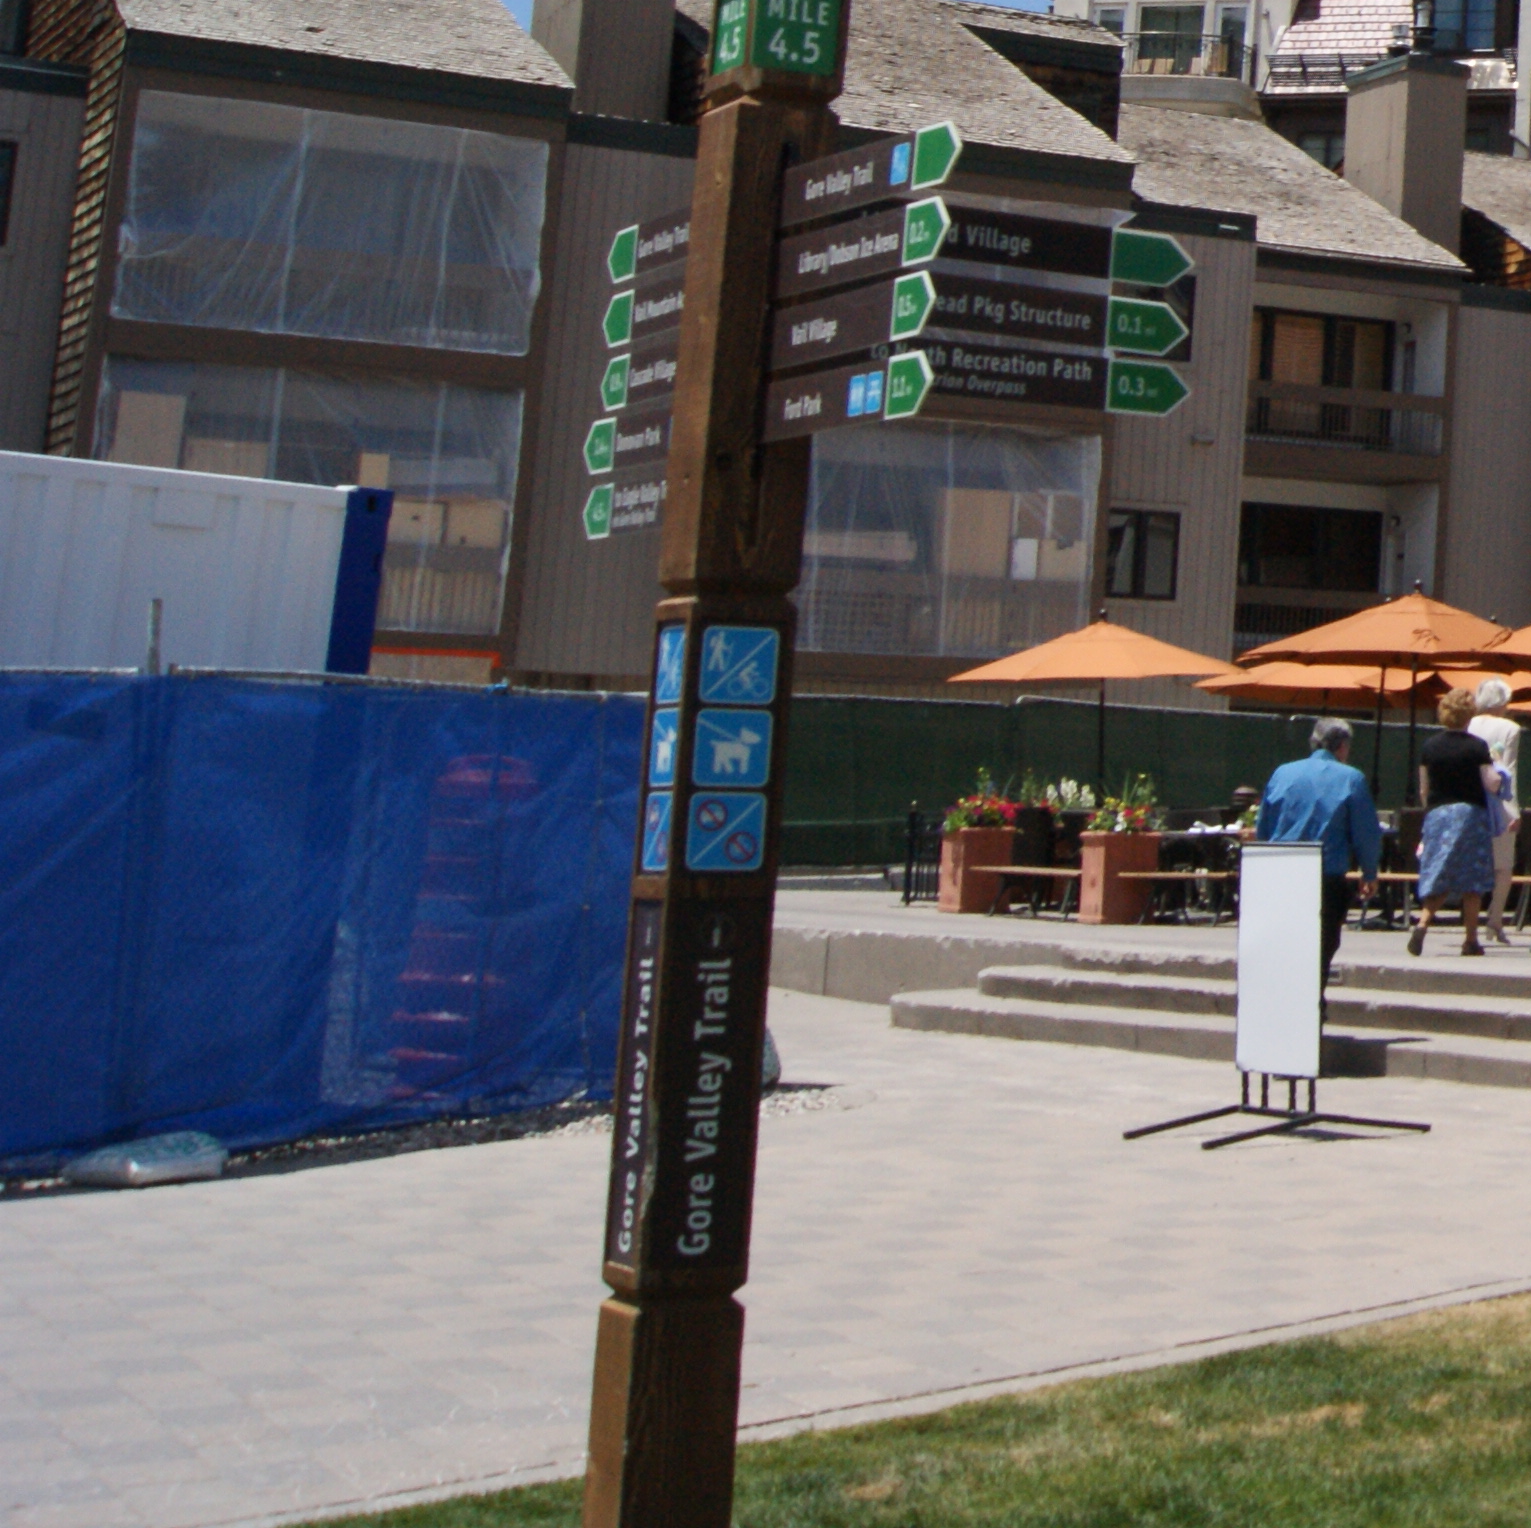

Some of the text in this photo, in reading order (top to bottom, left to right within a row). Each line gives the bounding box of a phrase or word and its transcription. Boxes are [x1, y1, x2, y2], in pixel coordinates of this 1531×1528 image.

[718, 26, 741, 64] 4.5
[768, 27, 821, 64] 4.5
[805, 161, 874, 201] Gore Valley Trail
[874, 232, 899, 255] Arena
[966, 225, 1032, 256] Village
[973, 296, 1004, 320] Pkg
[1010, 299, 1092, 330] Structure
[1117, 313, 1141, 333] 0.1
[809, 317, 838, 344] Village
[953, 347, 1047, 376] Recreation
[1053, 359, 1093, 381] Path
[967, 375, 1027, 396] Overpass
[1118, 376, 1145, 397] 0.3
[618, 956, 655, 1254] Gore Valley Trail
[677, 957, 732, 1256] Gore Valley Trail
